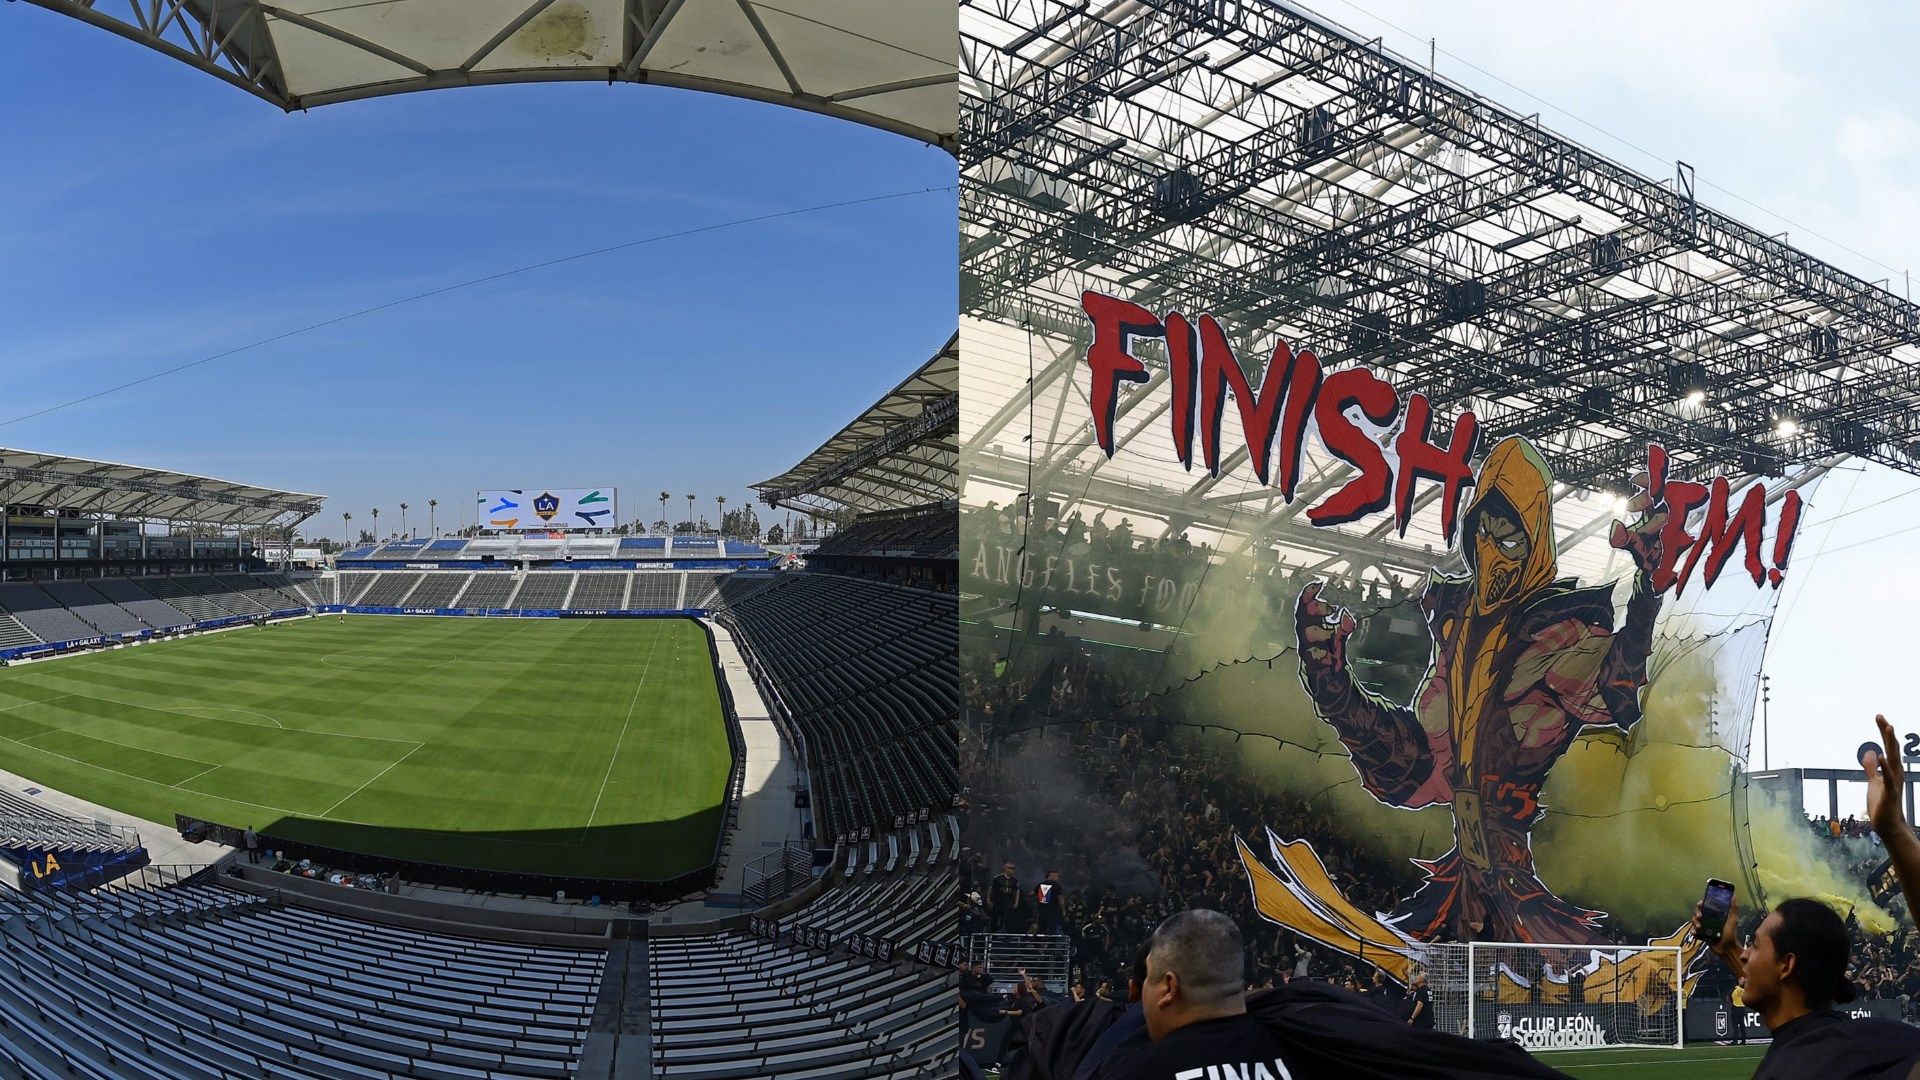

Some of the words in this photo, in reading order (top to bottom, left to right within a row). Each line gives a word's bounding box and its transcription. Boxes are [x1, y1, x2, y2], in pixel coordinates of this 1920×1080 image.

[1081, 289, 1479, 550] FINISH
[538, 501, 554, 511] LA
[971, 542, 1122, 601] ANGELES
[79, 637, 101, 646] GALAXY
[32, 853, 61, 879] LA
[1558, 1012, 1594, 1033] LEÓN
[1511, 1024, 1607, 1048] Scotiabank
